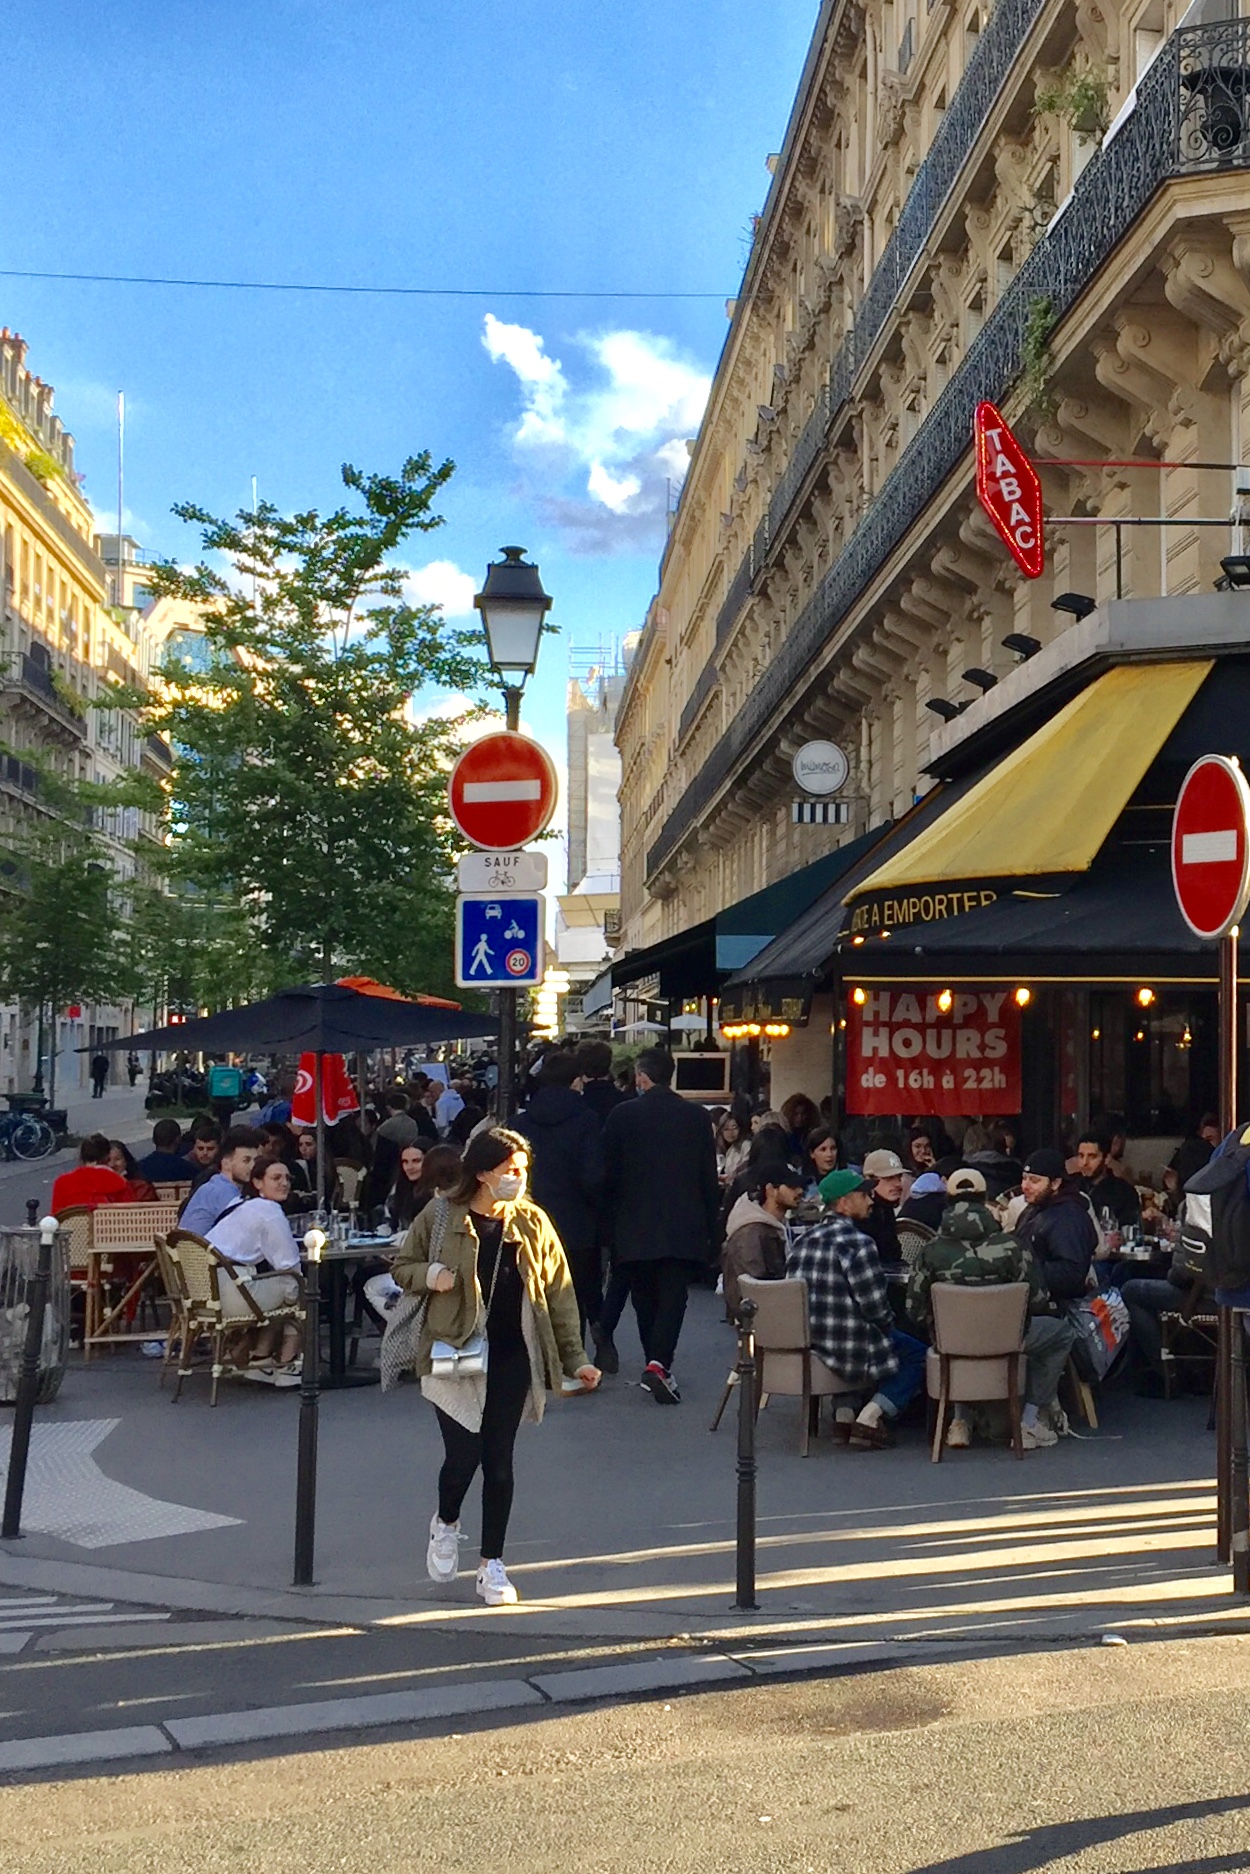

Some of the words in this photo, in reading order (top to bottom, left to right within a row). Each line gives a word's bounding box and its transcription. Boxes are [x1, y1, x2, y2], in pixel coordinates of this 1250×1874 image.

[986, 428, 1036, 549] TABAC
[484, 856, 520, 868] SAUF
[871, 903, 880, 927] A
[512, 957, 526, 968] 20
[861, 1026, 1008, 1059] HOURS
[861, 1067, 887, 1088] de
[897, 1068, 935, 1089] 16h
[942, 1070, 955, 1089] à
[963, 1066, 1007, 1089] 22h
